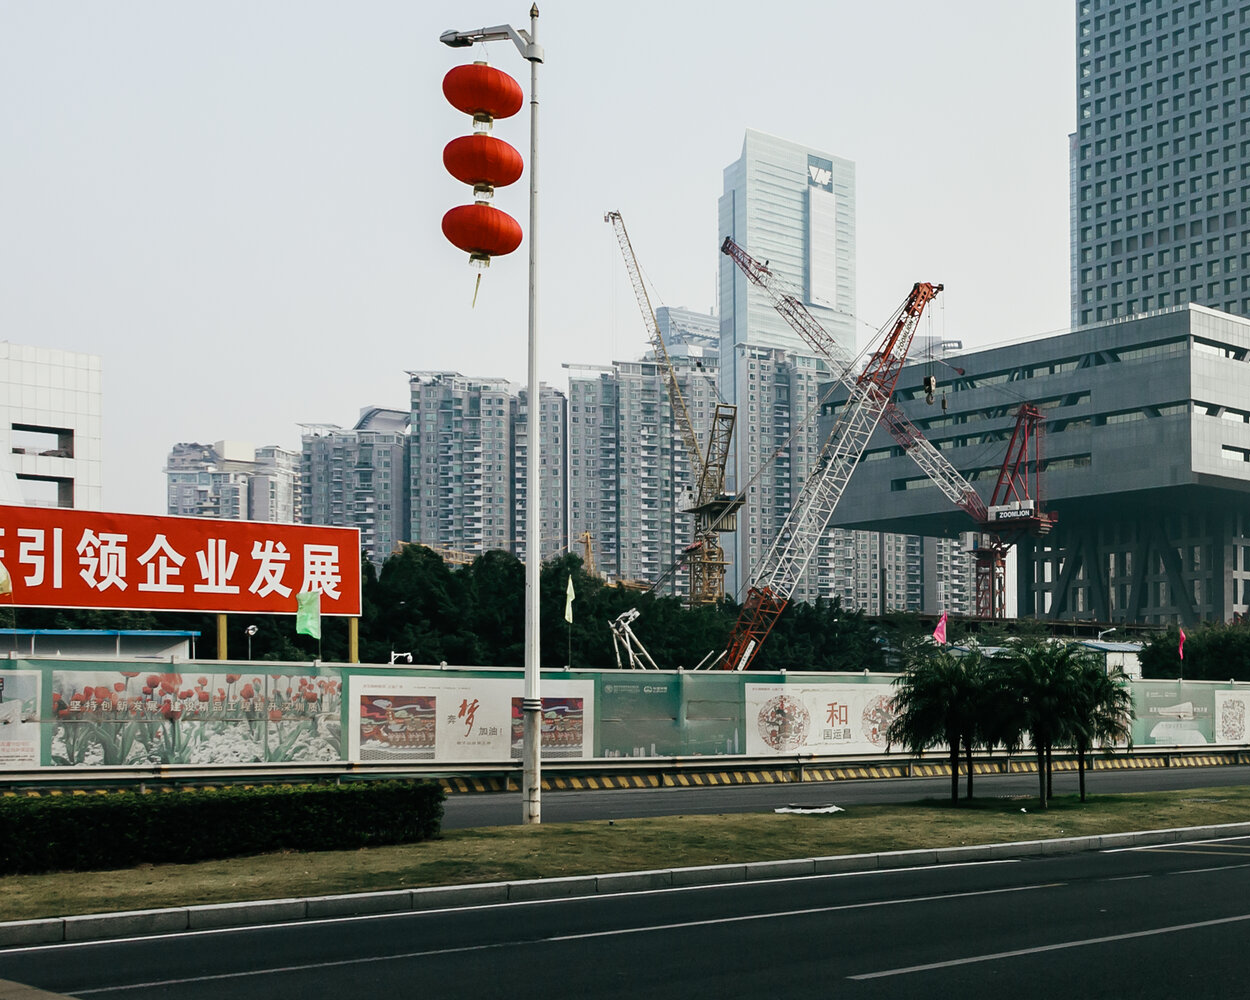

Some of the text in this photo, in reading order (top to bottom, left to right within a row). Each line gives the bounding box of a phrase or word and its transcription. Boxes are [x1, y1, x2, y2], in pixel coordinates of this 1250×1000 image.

[897, 320, 914, 352] ZOOMLION
[999, 509, 1030, 519] ZOOMLION
[0, 527, 342, 601] 引领企业发展
[826, 702, 849, 728] 和
[823, 728, 852, 740] 国运昌
